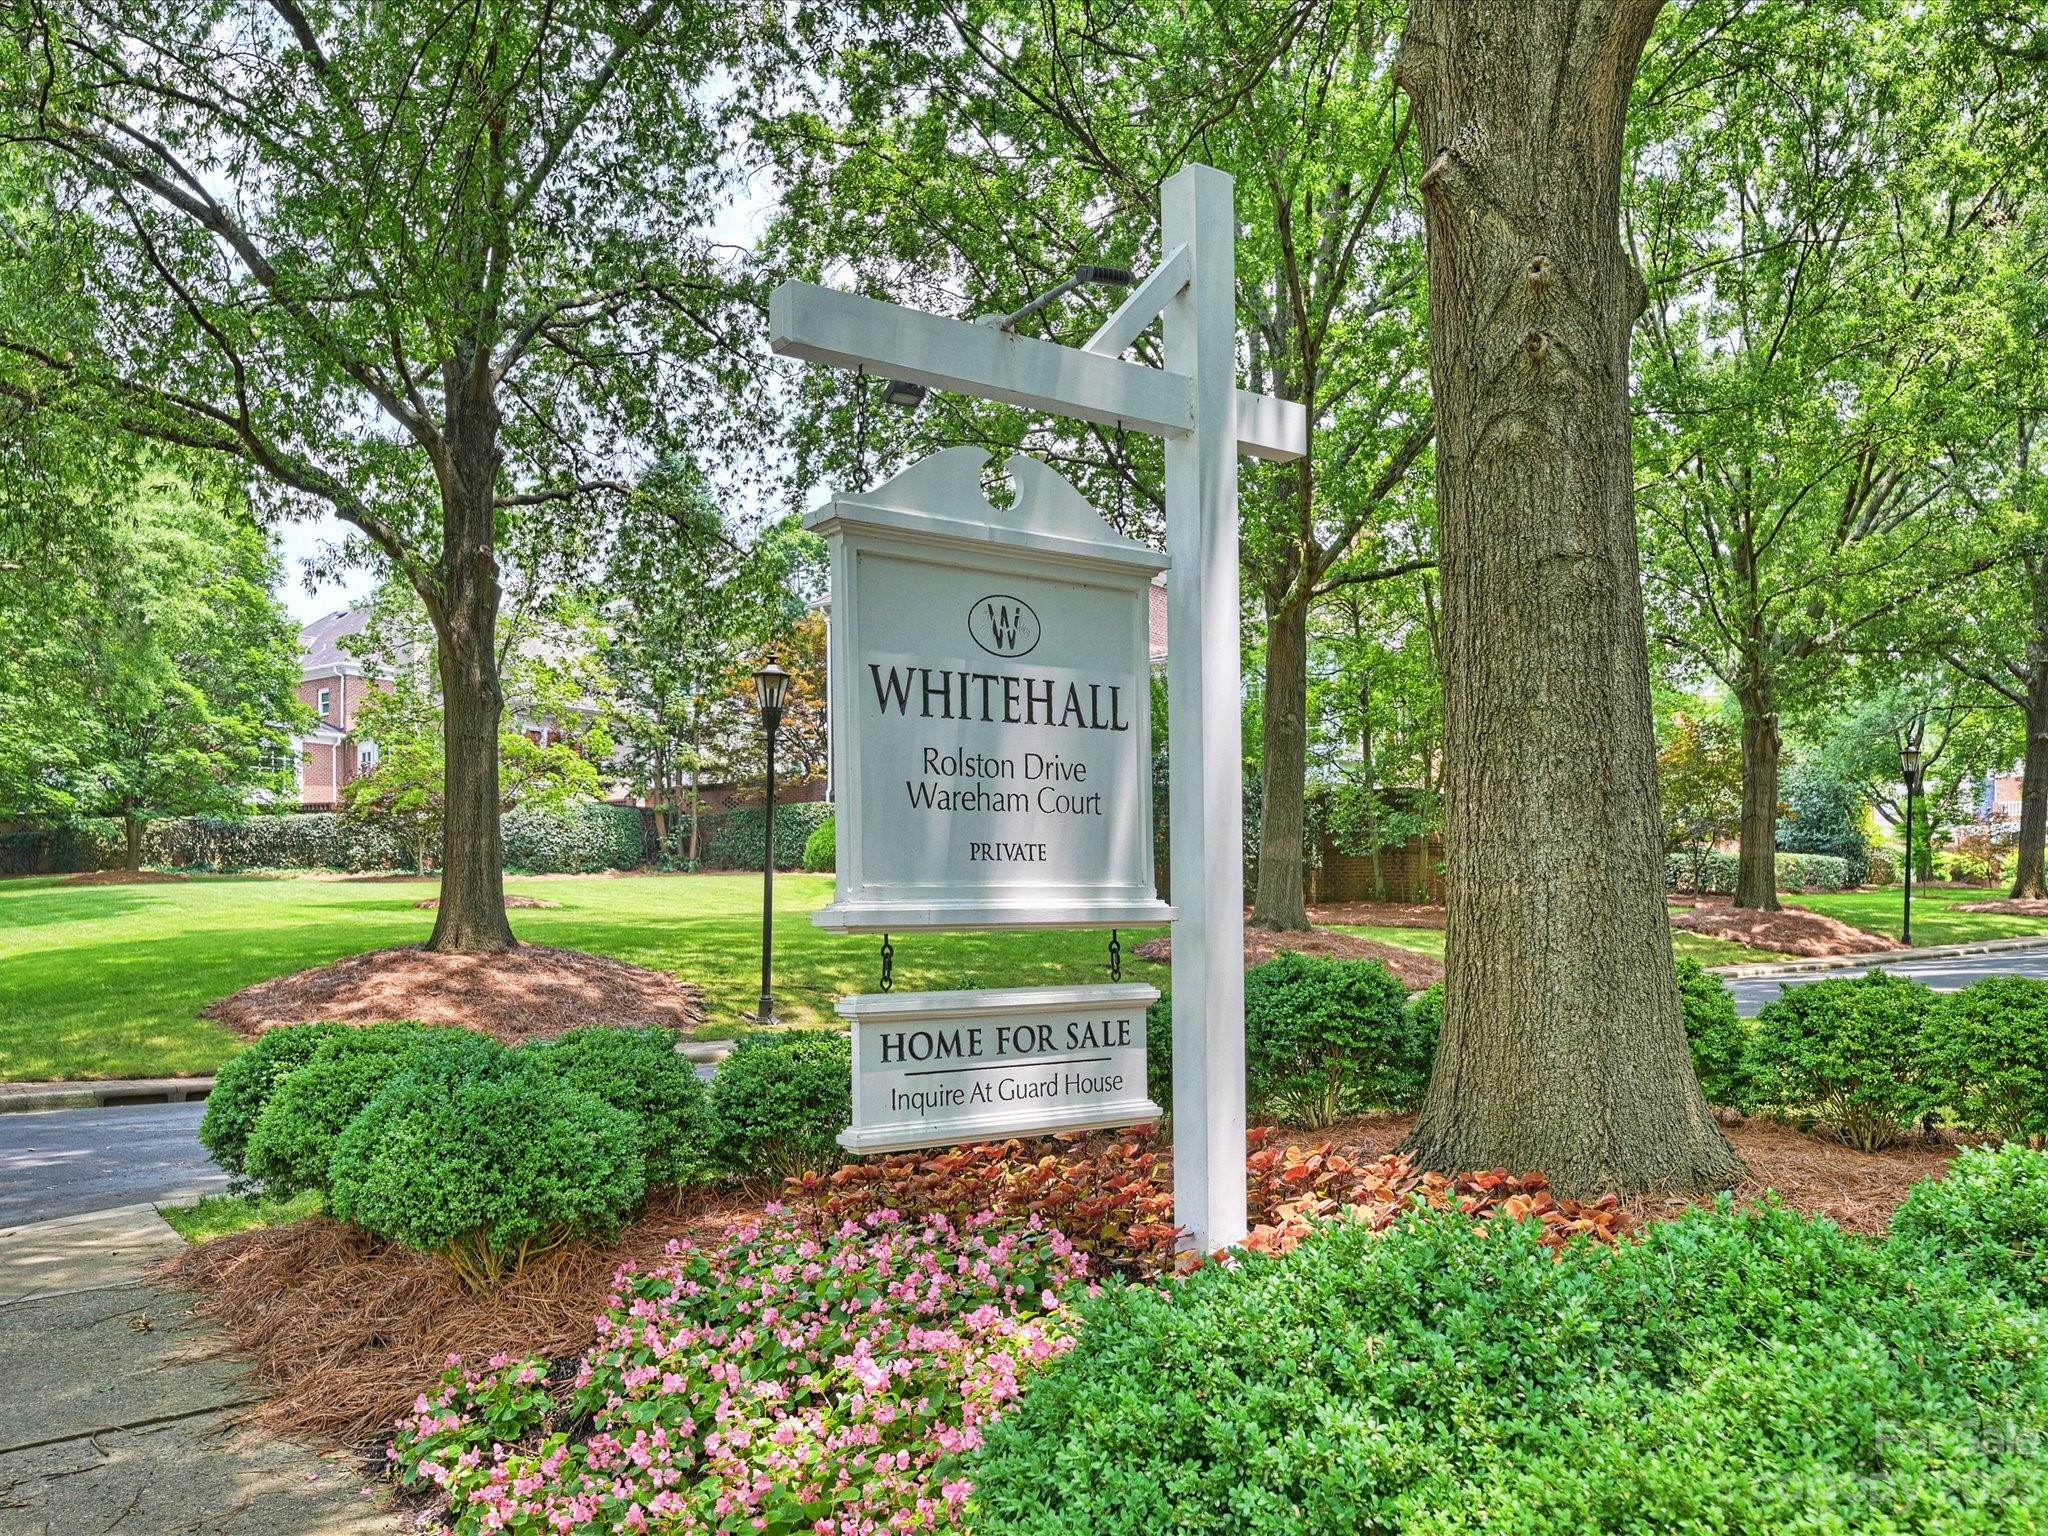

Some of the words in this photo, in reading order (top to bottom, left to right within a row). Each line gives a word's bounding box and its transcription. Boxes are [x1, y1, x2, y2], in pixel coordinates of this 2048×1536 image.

[868, 664, 1129, 731] WHITEHALL
[923, 747, 1014, 779] Rolston
[1025, 753, 1087, 782] Drive
[906, 781, 1029, 812] Wareham
[1038, 786, 1102, 816] Court
[970, 843, 1047, 862] PRIVATE
[880, 1029, 983, 1063] HOME
[996, 1024, 1058, 1055] FOR
[1066, 1019, 1131, 1049] SALE
[891, 1083, 964, 1116] Inquire
[970, 1082, 992, 1103] At
[999, 1073, 1058, 1101] Guard
[1065, 1073, 1123, 1095] House
